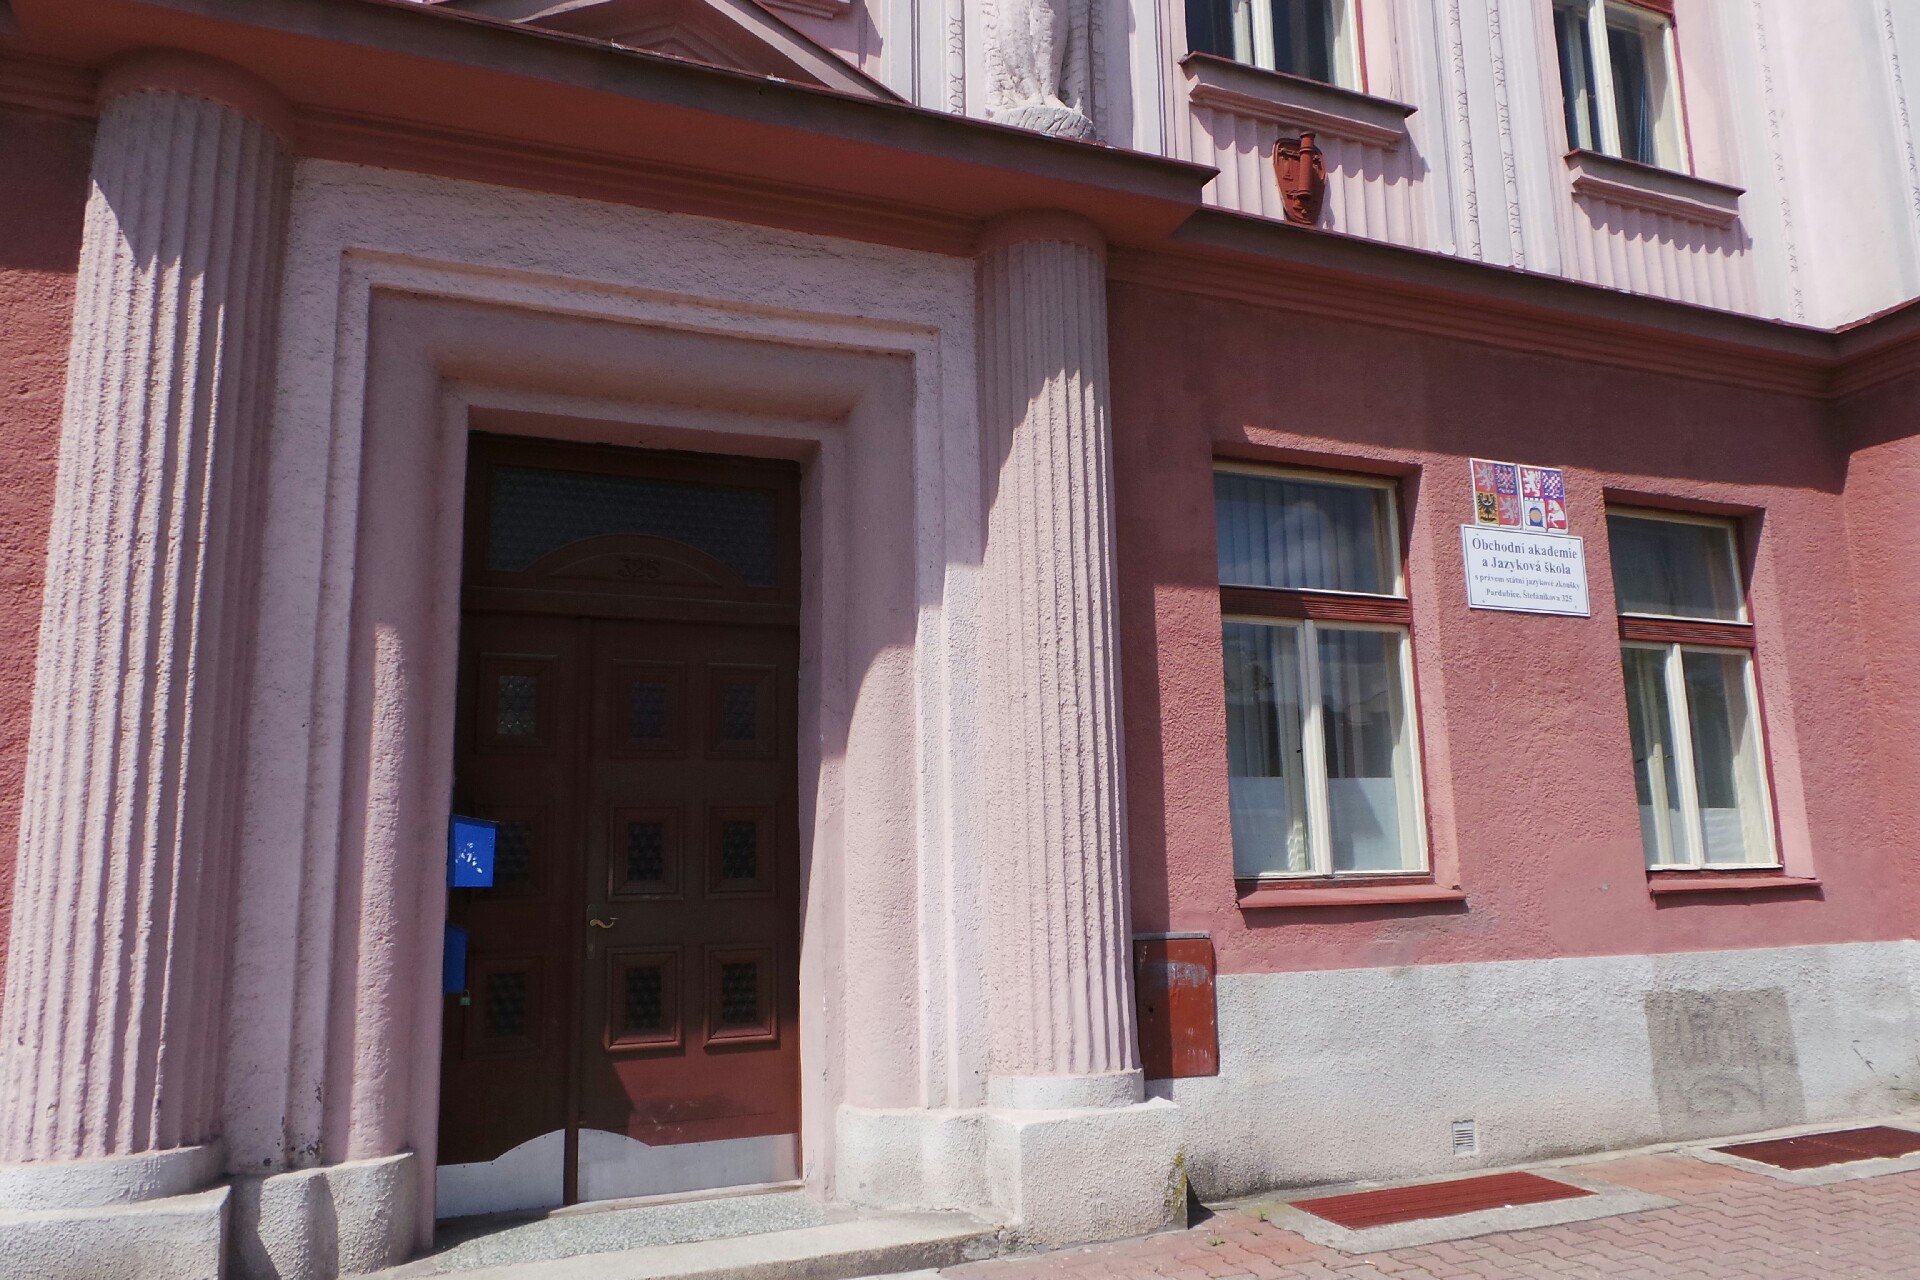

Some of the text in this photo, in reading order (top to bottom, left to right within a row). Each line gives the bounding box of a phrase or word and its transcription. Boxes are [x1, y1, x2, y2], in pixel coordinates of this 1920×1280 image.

[1472, 537, 1578, 559] Obchodní akademie
[618, 557, 661, 579] 325
[1482, 557, 1571, 575] a Jazyková škola
[1480, 574, 1504, 583] právem
[1506, 576, 1525, 585] státní
[1526, 579, 1554, 588] jazykové
[1555, 580, 1580, 591] zkoušky
[1561, 594, 1573, 603] 325
